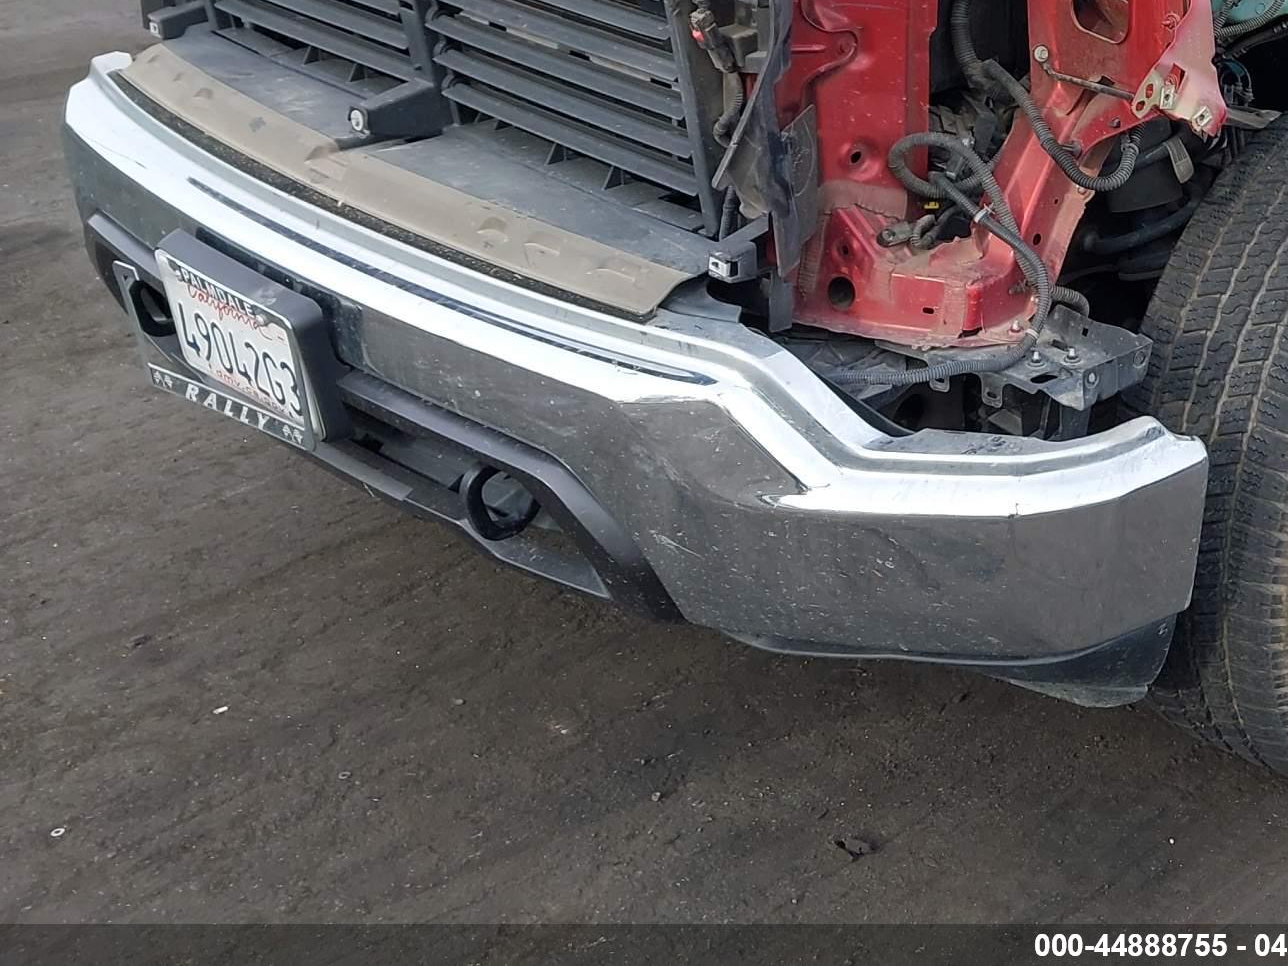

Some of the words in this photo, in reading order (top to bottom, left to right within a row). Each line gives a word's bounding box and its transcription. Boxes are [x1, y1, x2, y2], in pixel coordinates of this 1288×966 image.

[180, 266, 257, 319] PALMDALE
[187, 283, 273, 341] California
[178, 301, 304, 419] 49042G3
[185, 382, 271, 431] RALLY
